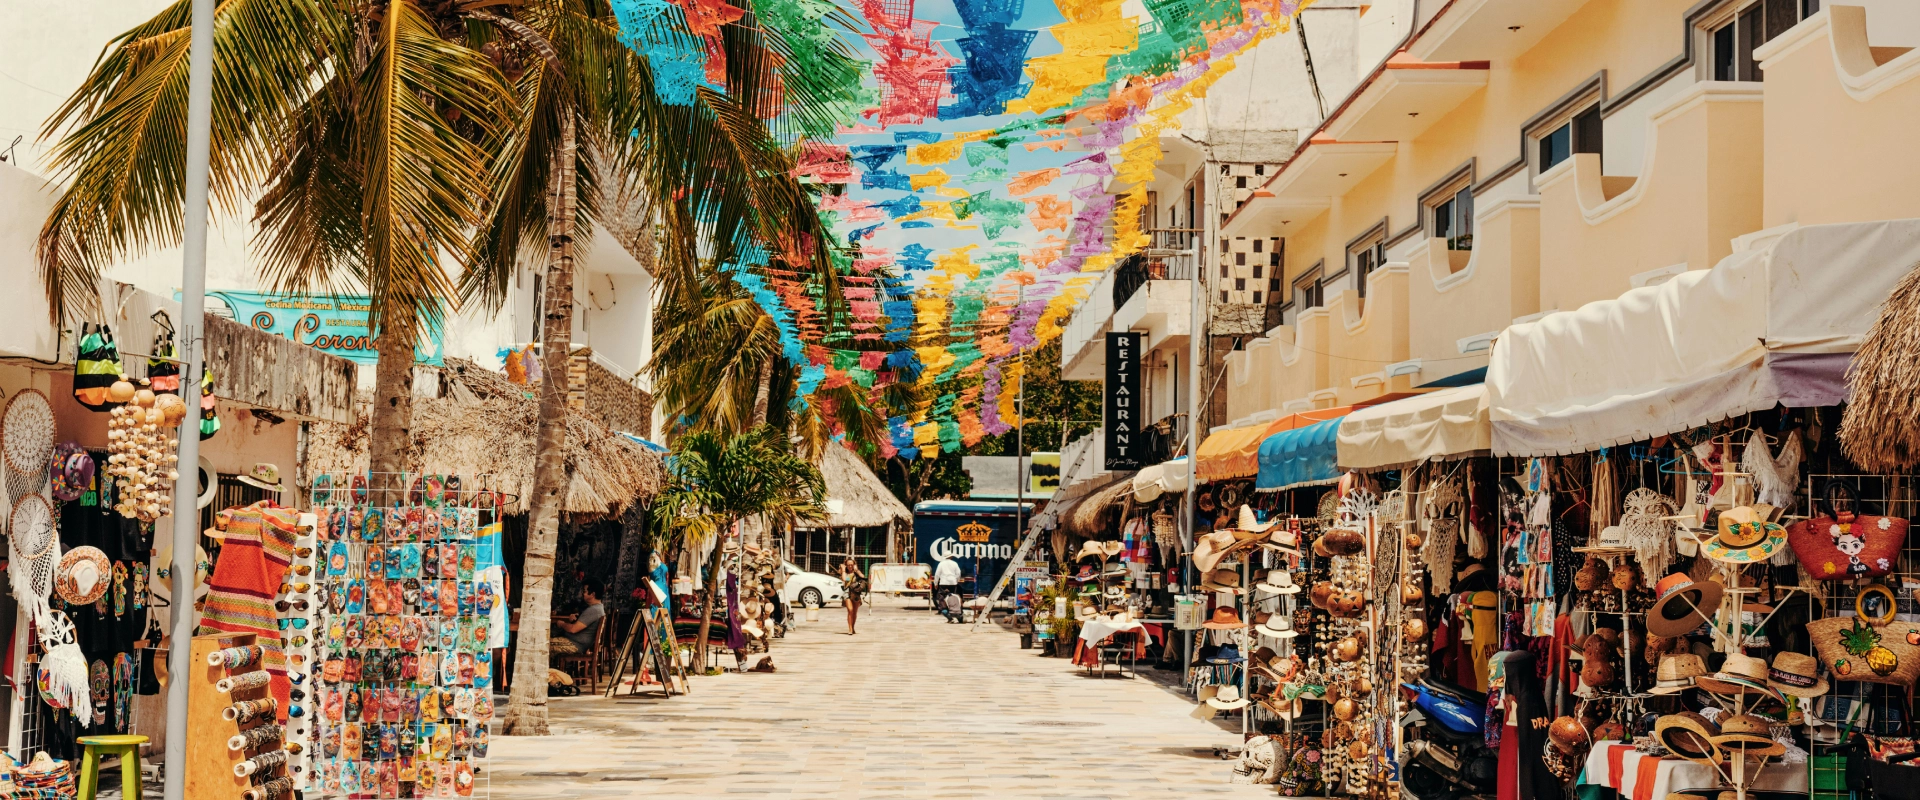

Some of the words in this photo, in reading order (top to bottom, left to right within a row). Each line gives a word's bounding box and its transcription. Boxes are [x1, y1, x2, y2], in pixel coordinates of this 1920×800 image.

[265, 299, 292, 309] Cocina
[326, 319, 369, 327] RESTAURA
[1116, 336, 1130, 456] RESTAURANT
[929, 536, 1012, 562] Corona
